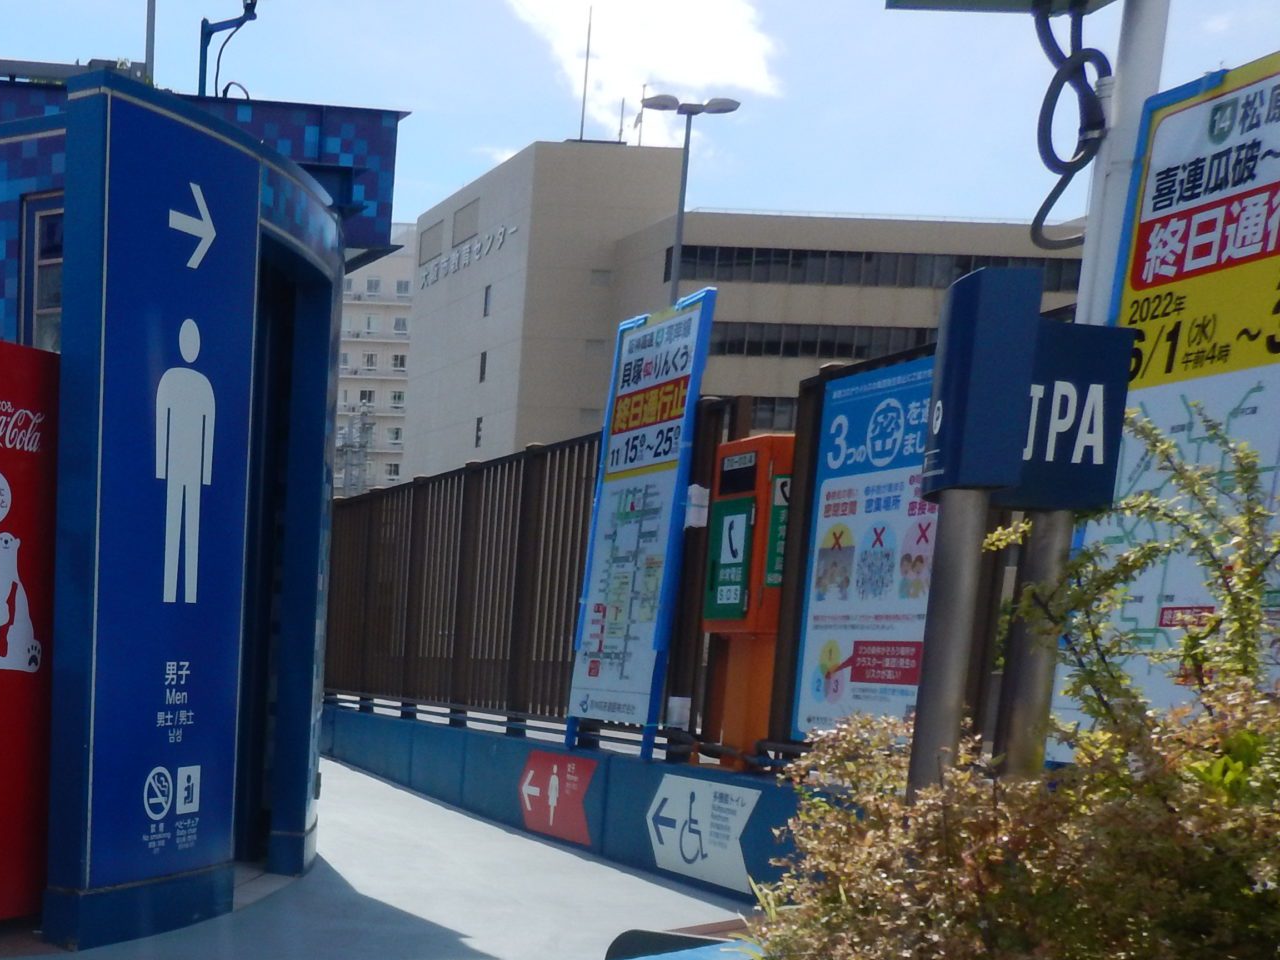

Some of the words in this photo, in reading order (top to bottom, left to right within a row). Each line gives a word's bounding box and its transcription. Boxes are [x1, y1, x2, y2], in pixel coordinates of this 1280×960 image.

[1128, 291, 1187, 326] 2022年
[164, 661, 191, 686] 男子
[165, 688, 188, 705] Men
